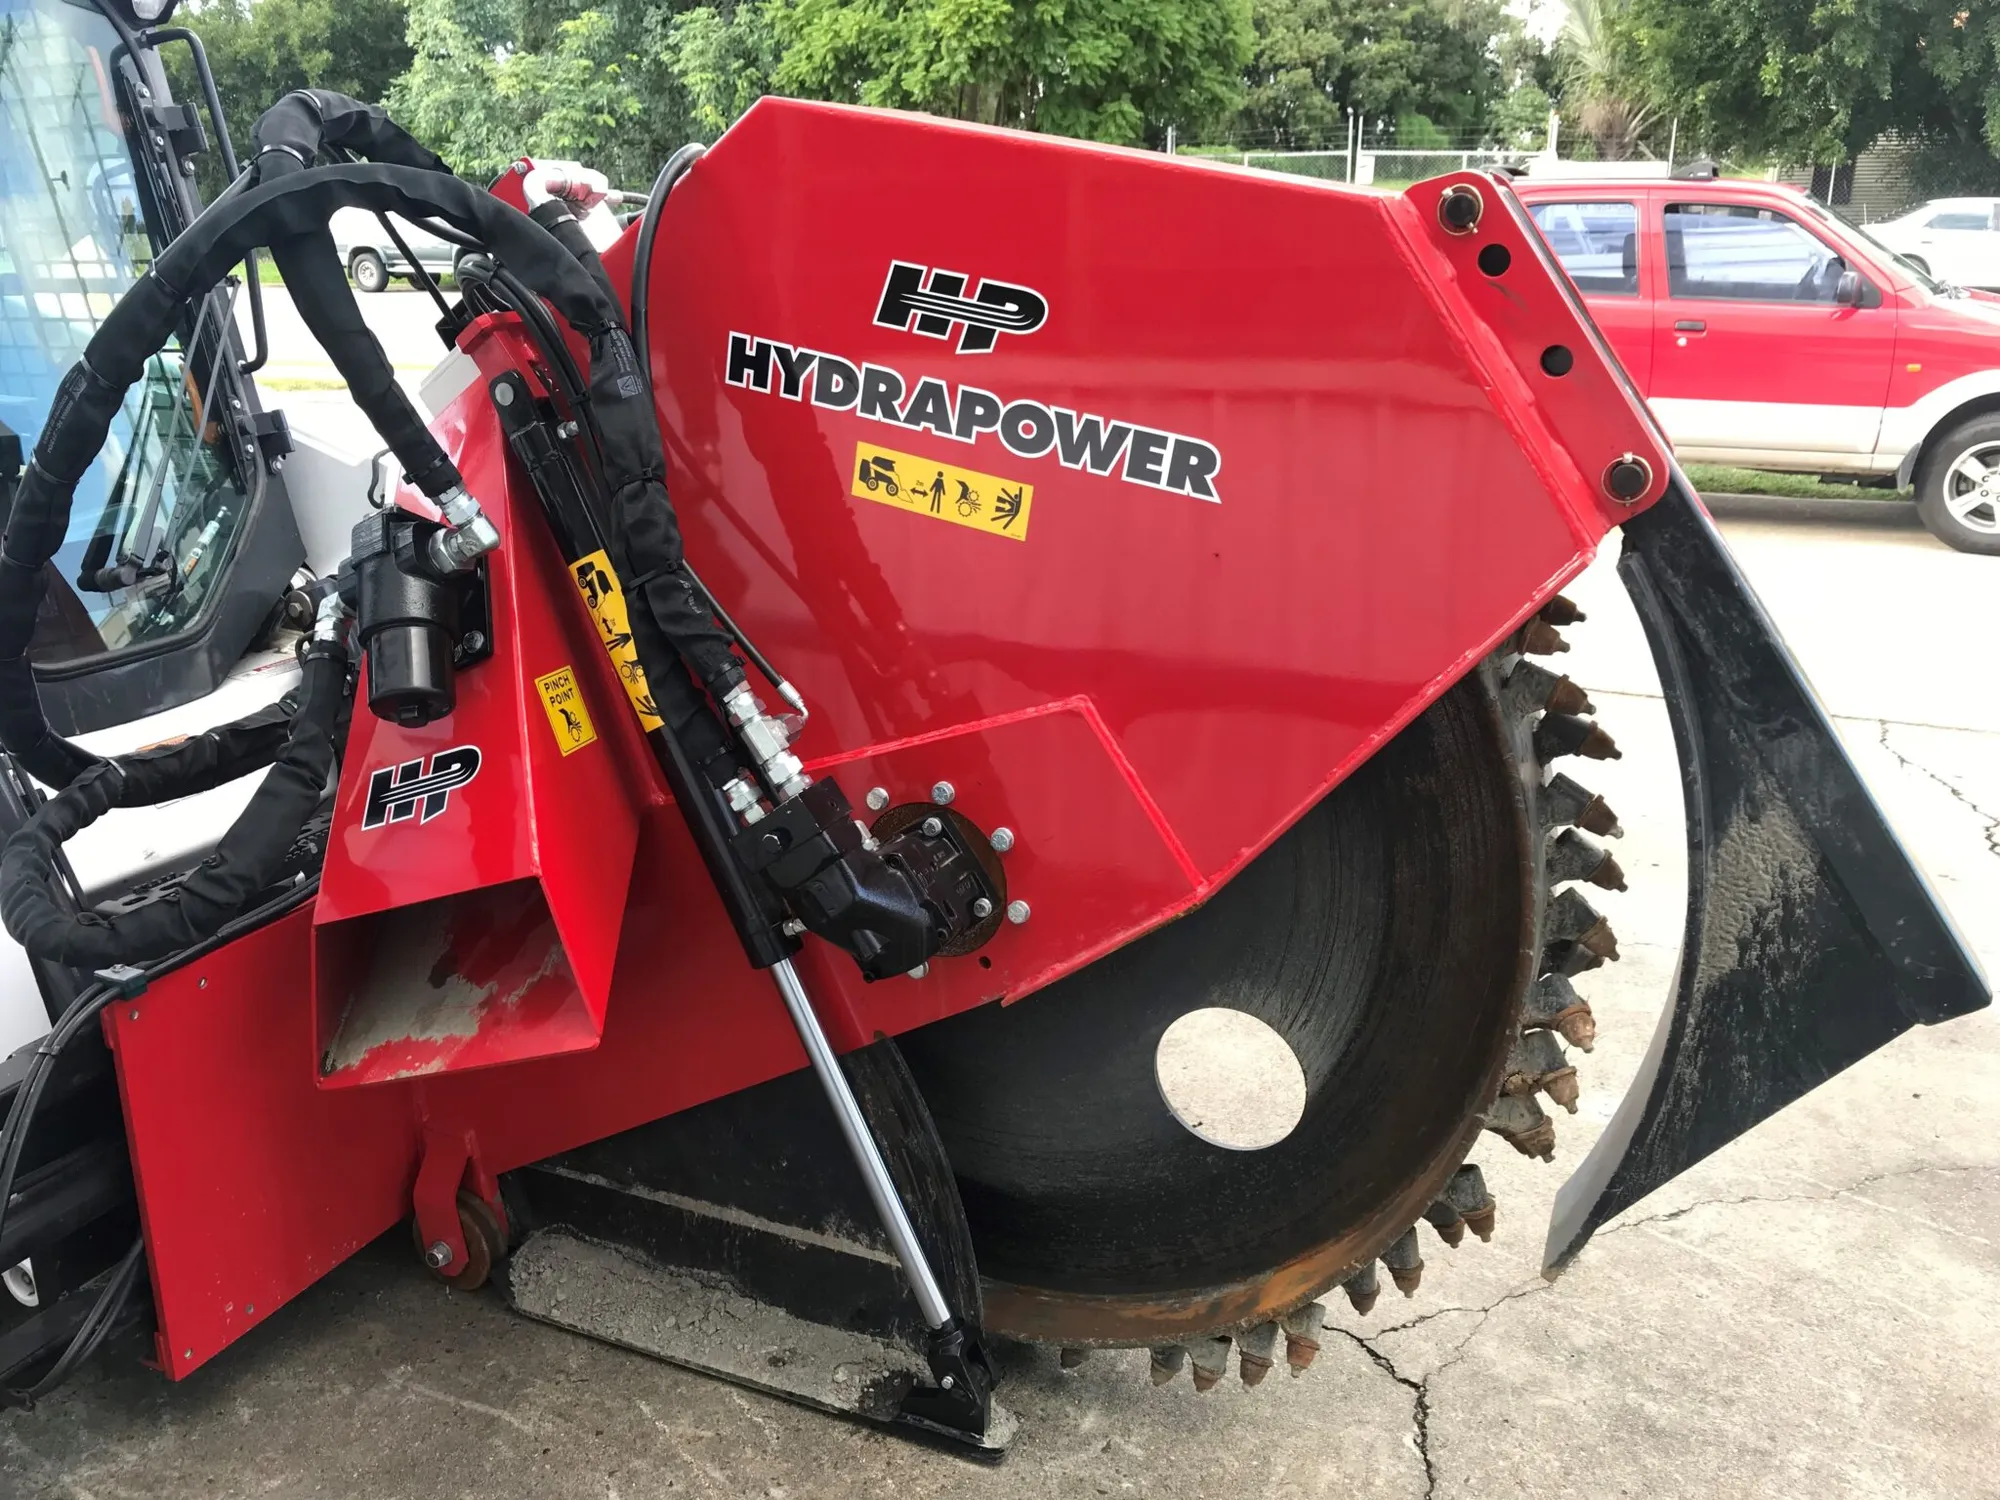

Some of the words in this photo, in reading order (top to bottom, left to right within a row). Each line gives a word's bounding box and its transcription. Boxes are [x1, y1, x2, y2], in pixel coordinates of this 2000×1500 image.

[873, 259, 1049, 354] HP
[725, 331, 1221, 503] HYDRAPOWER
[543, 674, 571, 693] PINCH
[549, 688, 575, 707] POINT
[361, 744, 482, 831] HP
